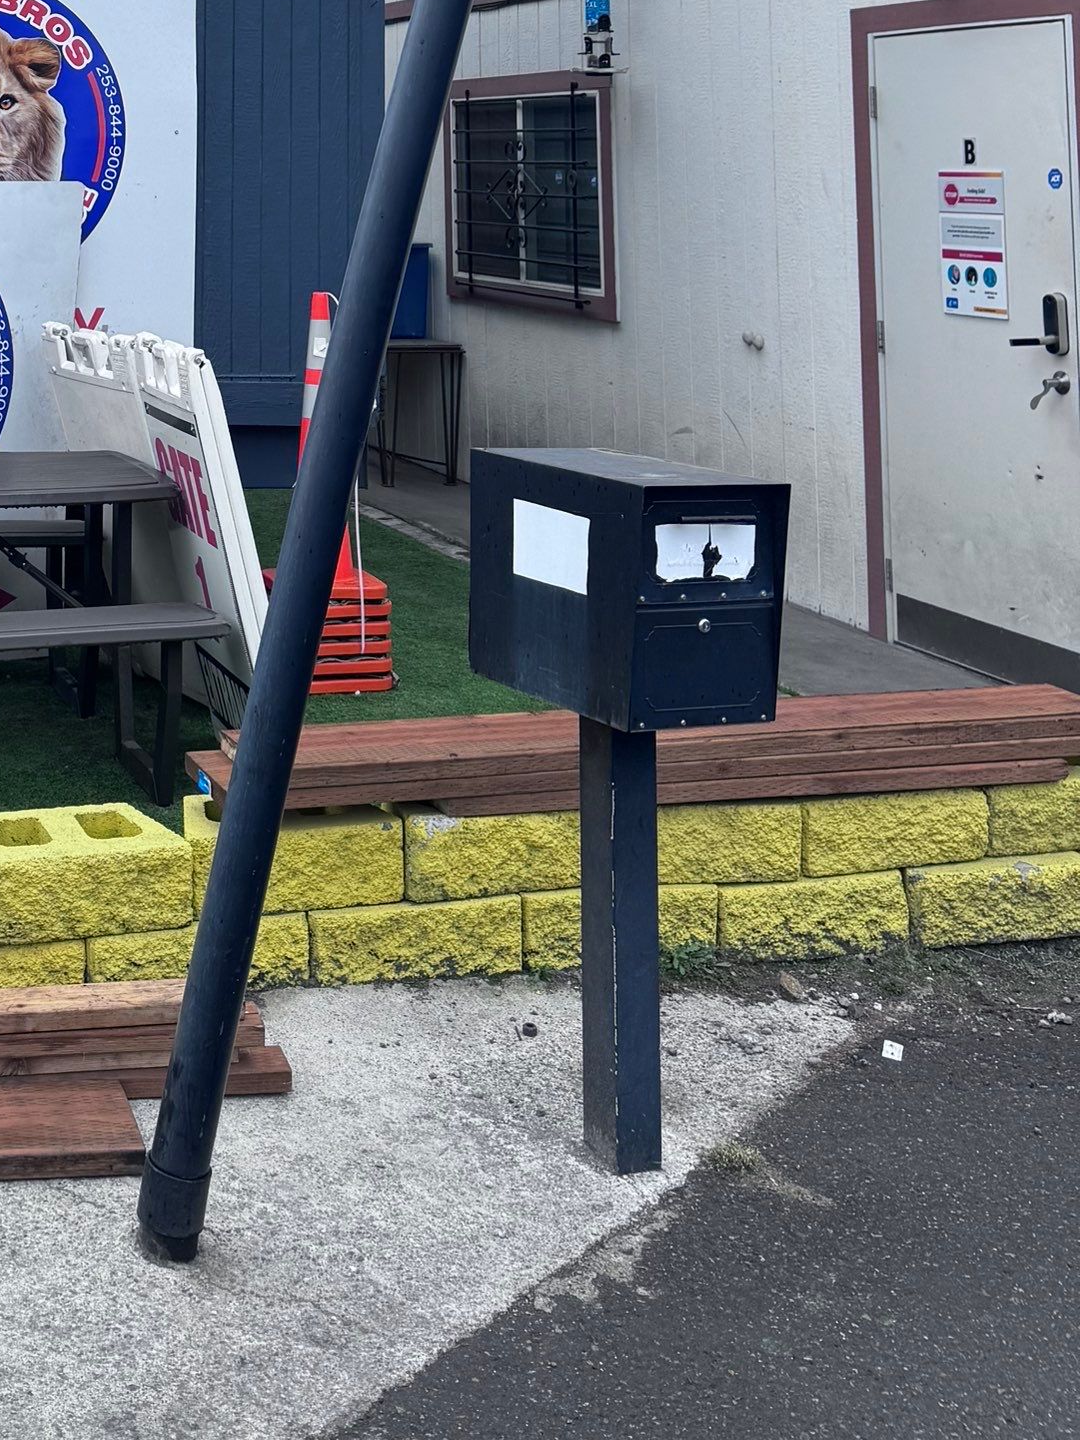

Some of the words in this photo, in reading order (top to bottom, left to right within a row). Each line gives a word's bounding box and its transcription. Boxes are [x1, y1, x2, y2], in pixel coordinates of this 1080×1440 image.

[94, 63, 124, 192] 253-844-9000
[964, 139, 976, 165] B
[154, 436, 219, 550] GATE
[193, 555, 213, 610] 1
